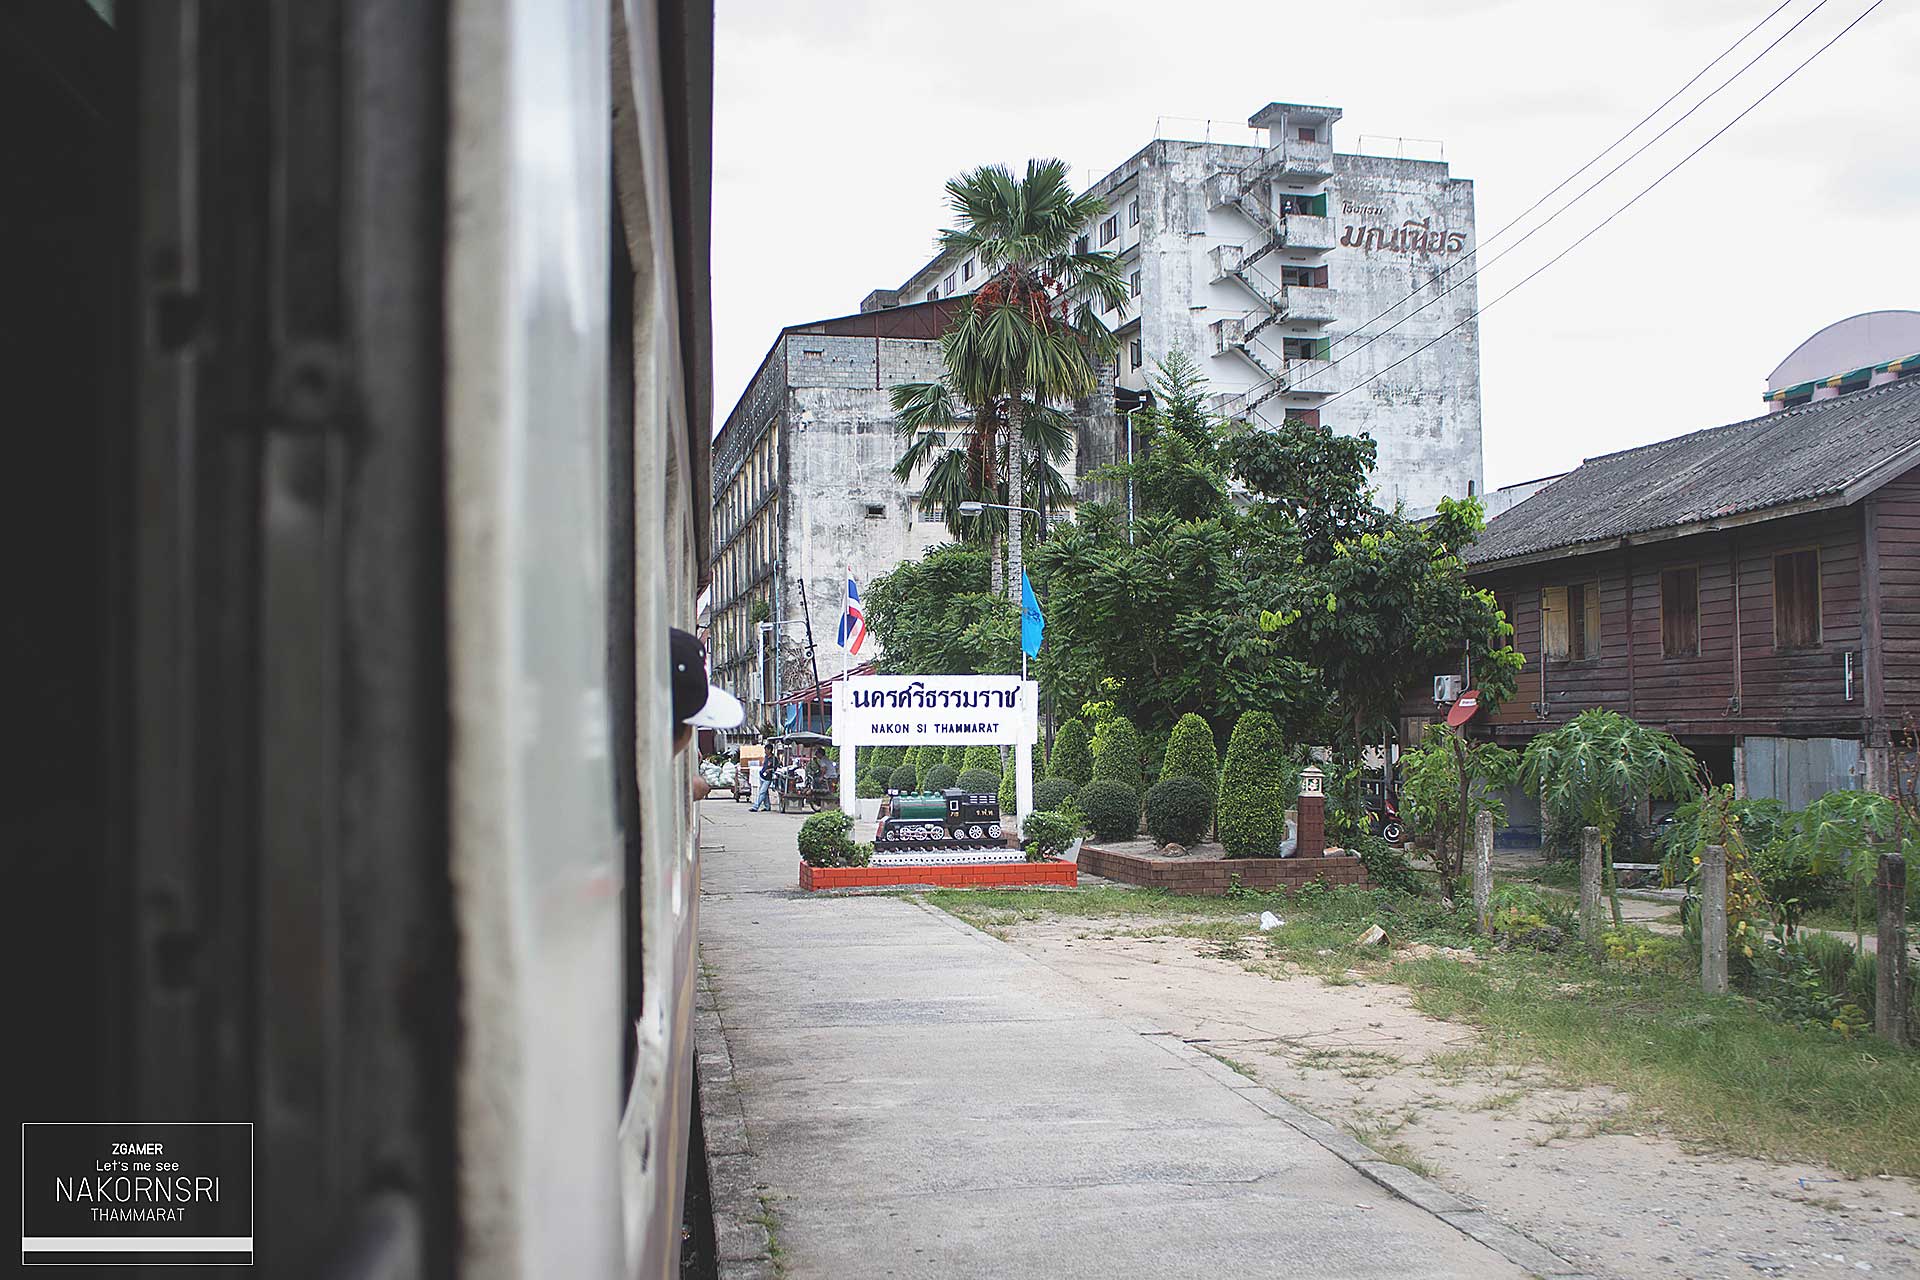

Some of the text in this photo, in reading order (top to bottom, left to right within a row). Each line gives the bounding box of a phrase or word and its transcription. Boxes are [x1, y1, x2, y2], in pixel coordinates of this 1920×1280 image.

[1342, 200, 1384, 215] โรงแรม
[853, 681, 1021, 708] นครศรีธรรมราช
[871, 723, 999, 734] NAKON SI THAMMARAT
